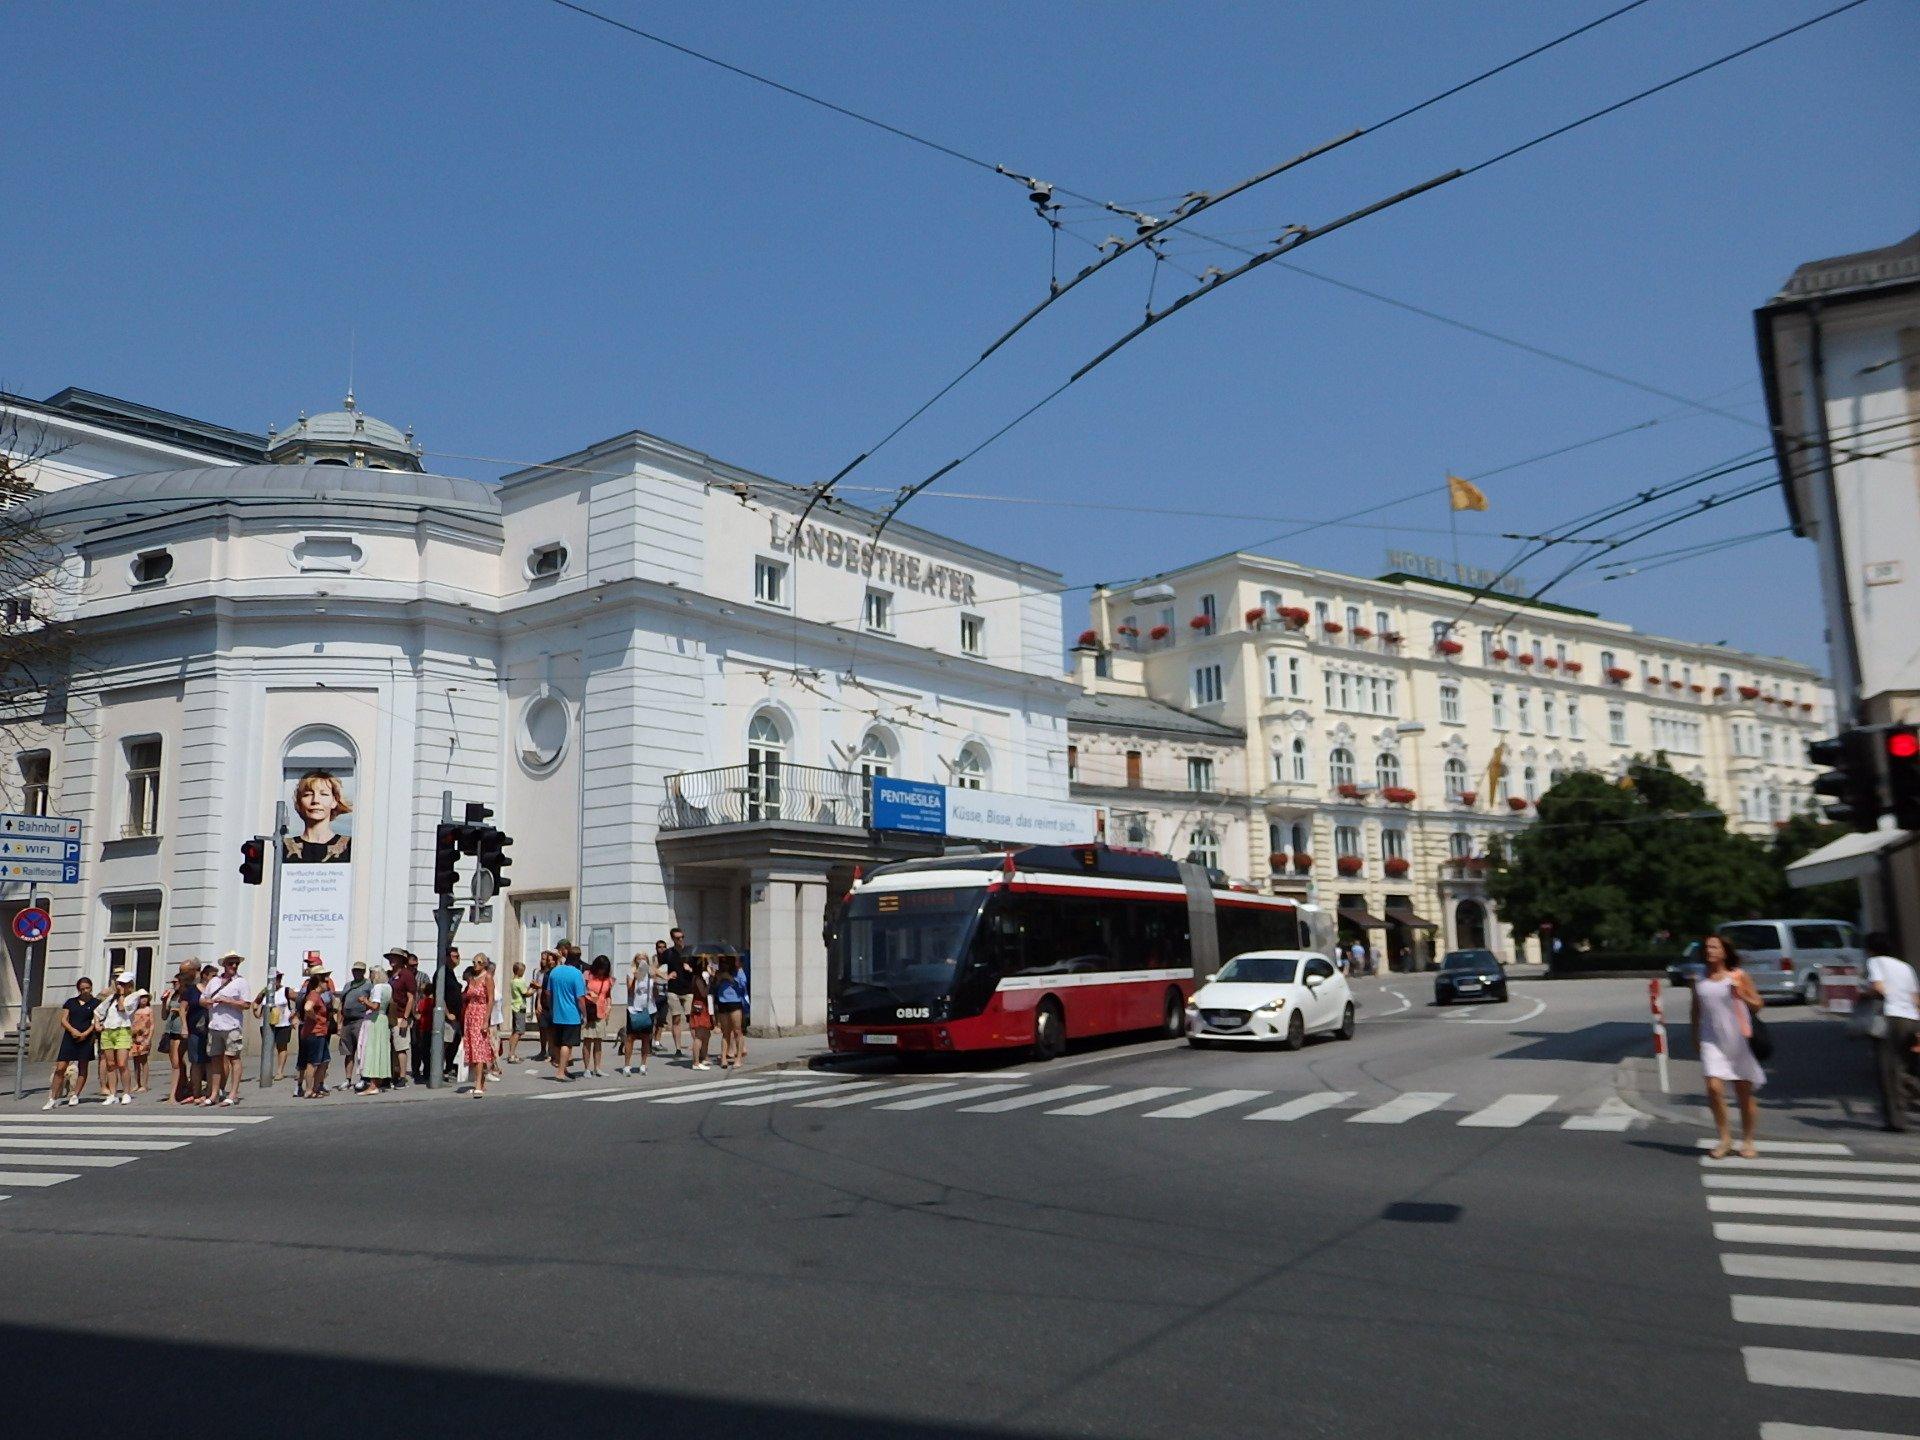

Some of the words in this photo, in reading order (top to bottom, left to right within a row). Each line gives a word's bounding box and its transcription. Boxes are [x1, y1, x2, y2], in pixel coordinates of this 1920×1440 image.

[769, 512, 976, 607] LANDESTHEATER
[880, 789, 941, 808] PENTHESILEA
[952, 806, 983, 823] Küsse,
[986, 809, 1013, 827] Bisse,
[1016, 814, 1032, 828] das
[18, 820, 60, 833] Bahnhof
[25, 844, 51, 854] WIFI
[22, 866, 62, 877] Raiffeisen
[282, 913, 345, 922] PENTHESILEA
[896, 1007, 930, 1019] OBUS
